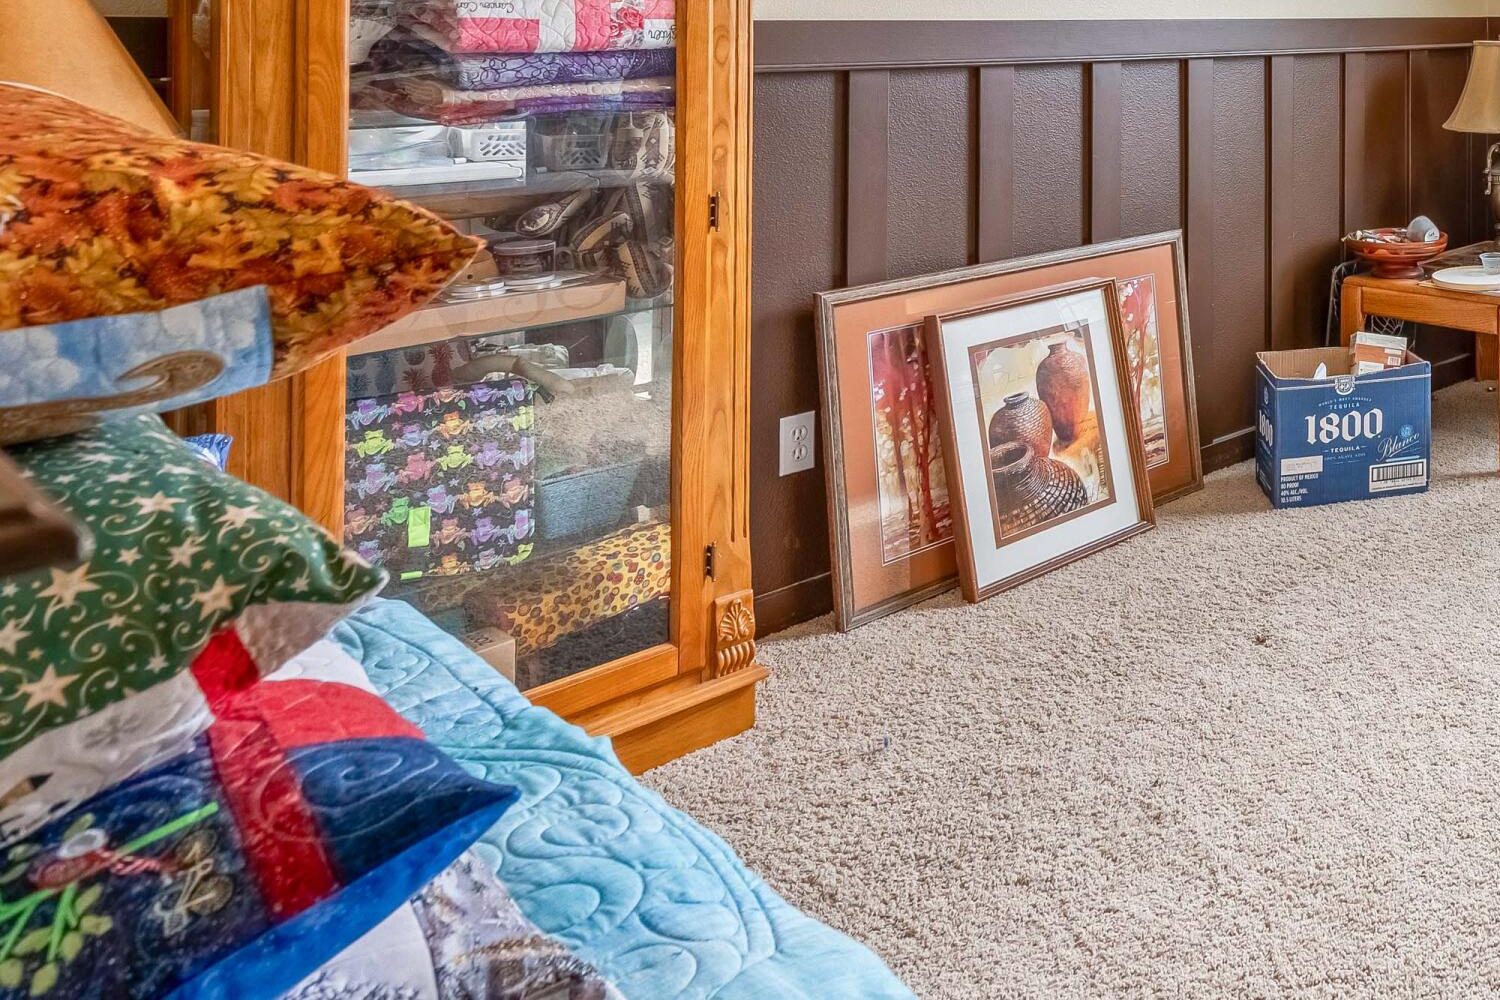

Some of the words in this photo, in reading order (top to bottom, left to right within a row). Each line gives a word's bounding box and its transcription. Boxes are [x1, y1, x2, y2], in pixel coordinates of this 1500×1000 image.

[1305, 408, 1383, 445] 1800
[1330, 445, 1361, 454] TEQUILA
[1376, 433, 1420, 461] Blanco
